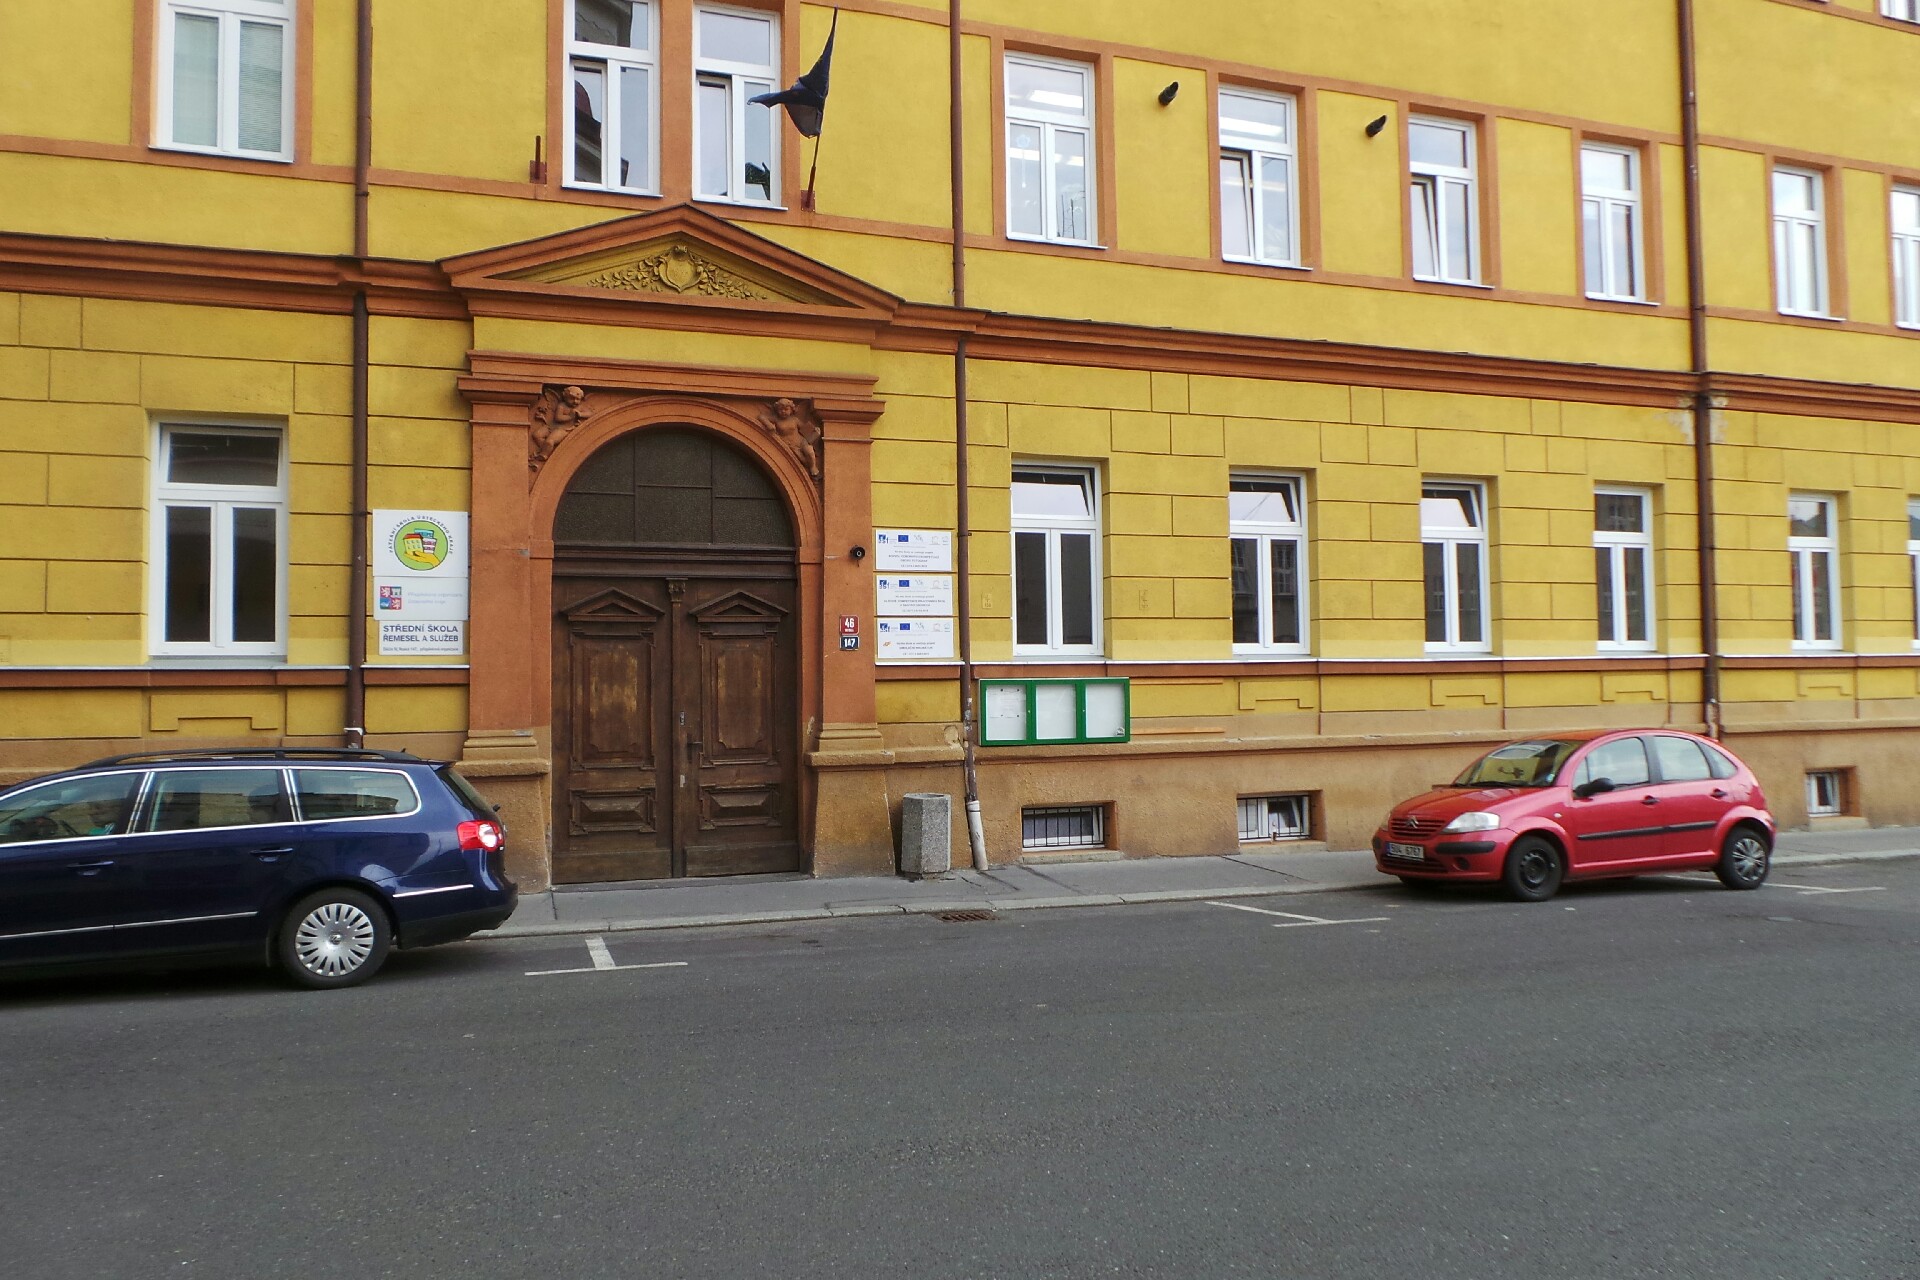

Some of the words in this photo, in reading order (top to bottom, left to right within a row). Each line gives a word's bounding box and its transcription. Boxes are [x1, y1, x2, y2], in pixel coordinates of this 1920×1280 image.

[844, 617, 855, 628] 46
[383, 623, 425, 633] STŘEDNÍ
[427, 623, 459, 633] ŠKOLA
[383, 634, 420, 642] ŘEMESEL
[422, 634, 428, 642] A
[429, 634, 459, 642] SLUŽEB
[844, 638, 856, 648] 147
